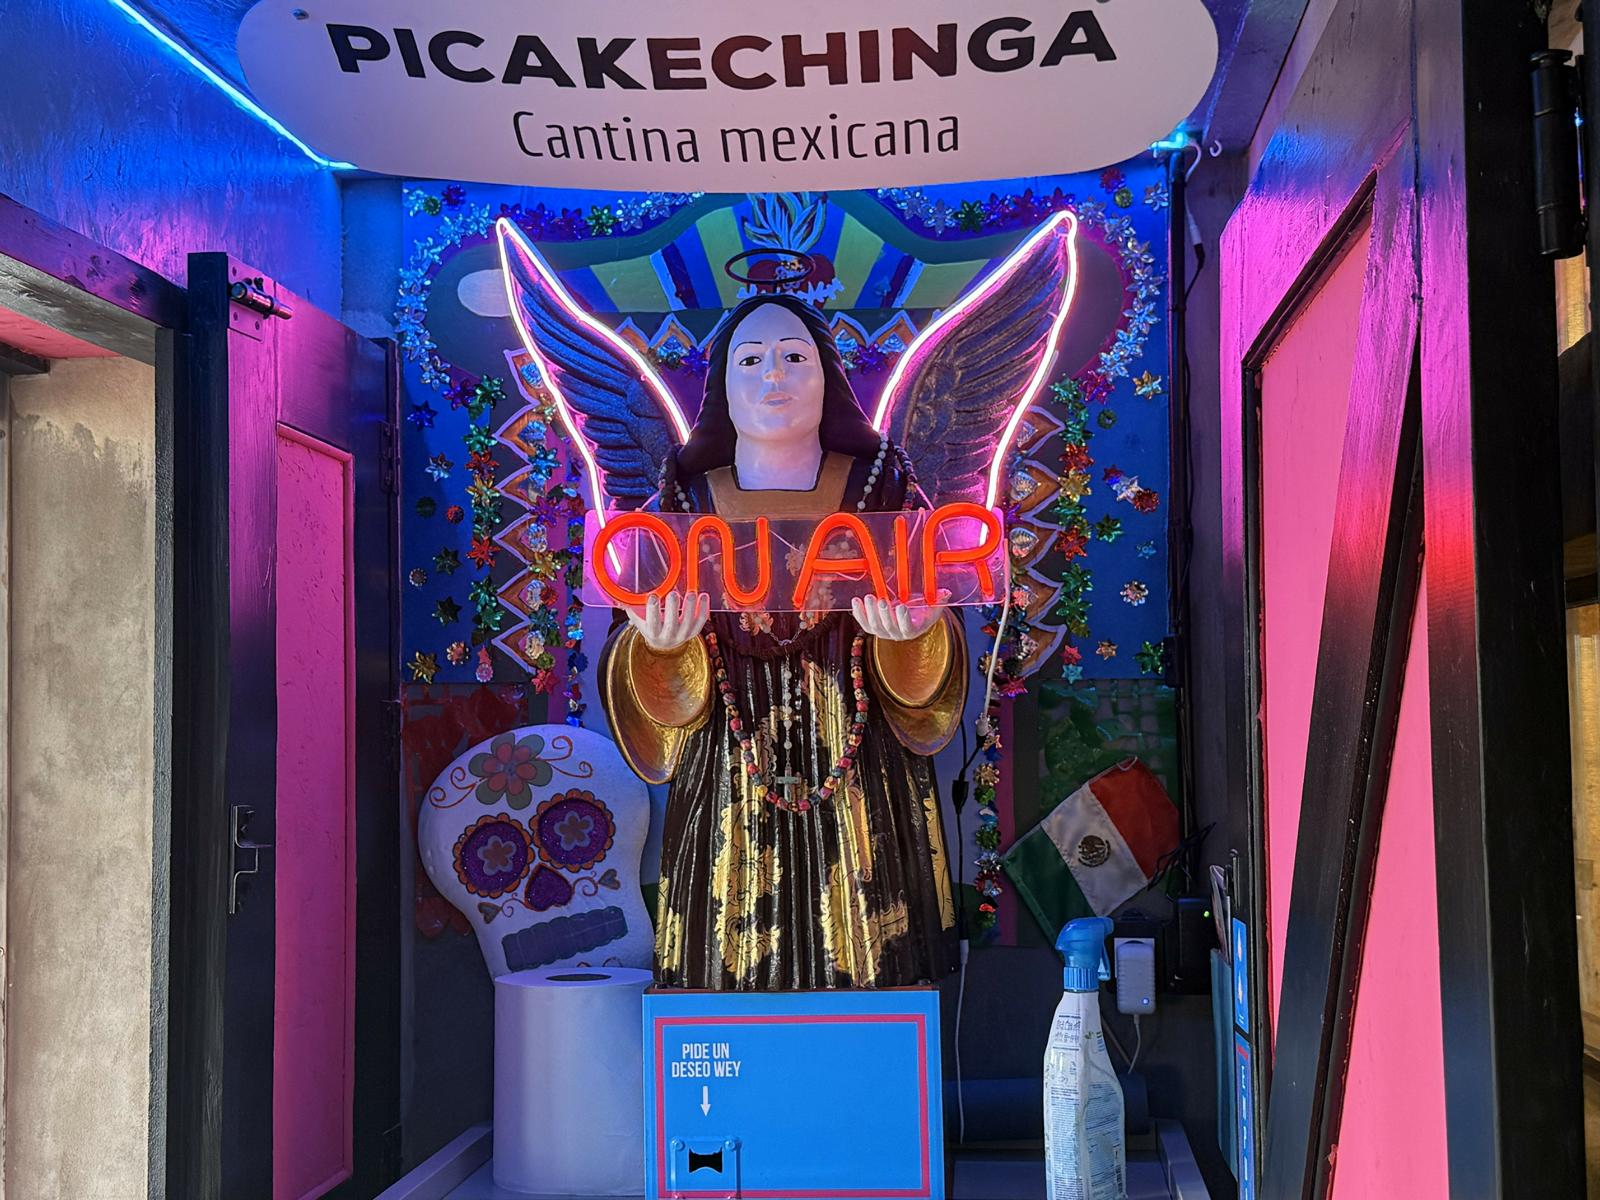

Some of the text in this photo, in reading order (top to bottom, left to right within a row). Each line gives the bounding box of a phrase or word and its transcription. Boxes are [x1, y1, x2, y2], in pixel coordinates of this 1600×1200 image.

[327, 10, 1117, 91] PICAKECHINGA
[513, 111, 960, 164] Cantina mexicana
[592, 502, 1002, 608] ON AIR
[671, 1061, 741, 1078] DESEO WEY
[682, 1042, 730, 1060] PIDE UN
